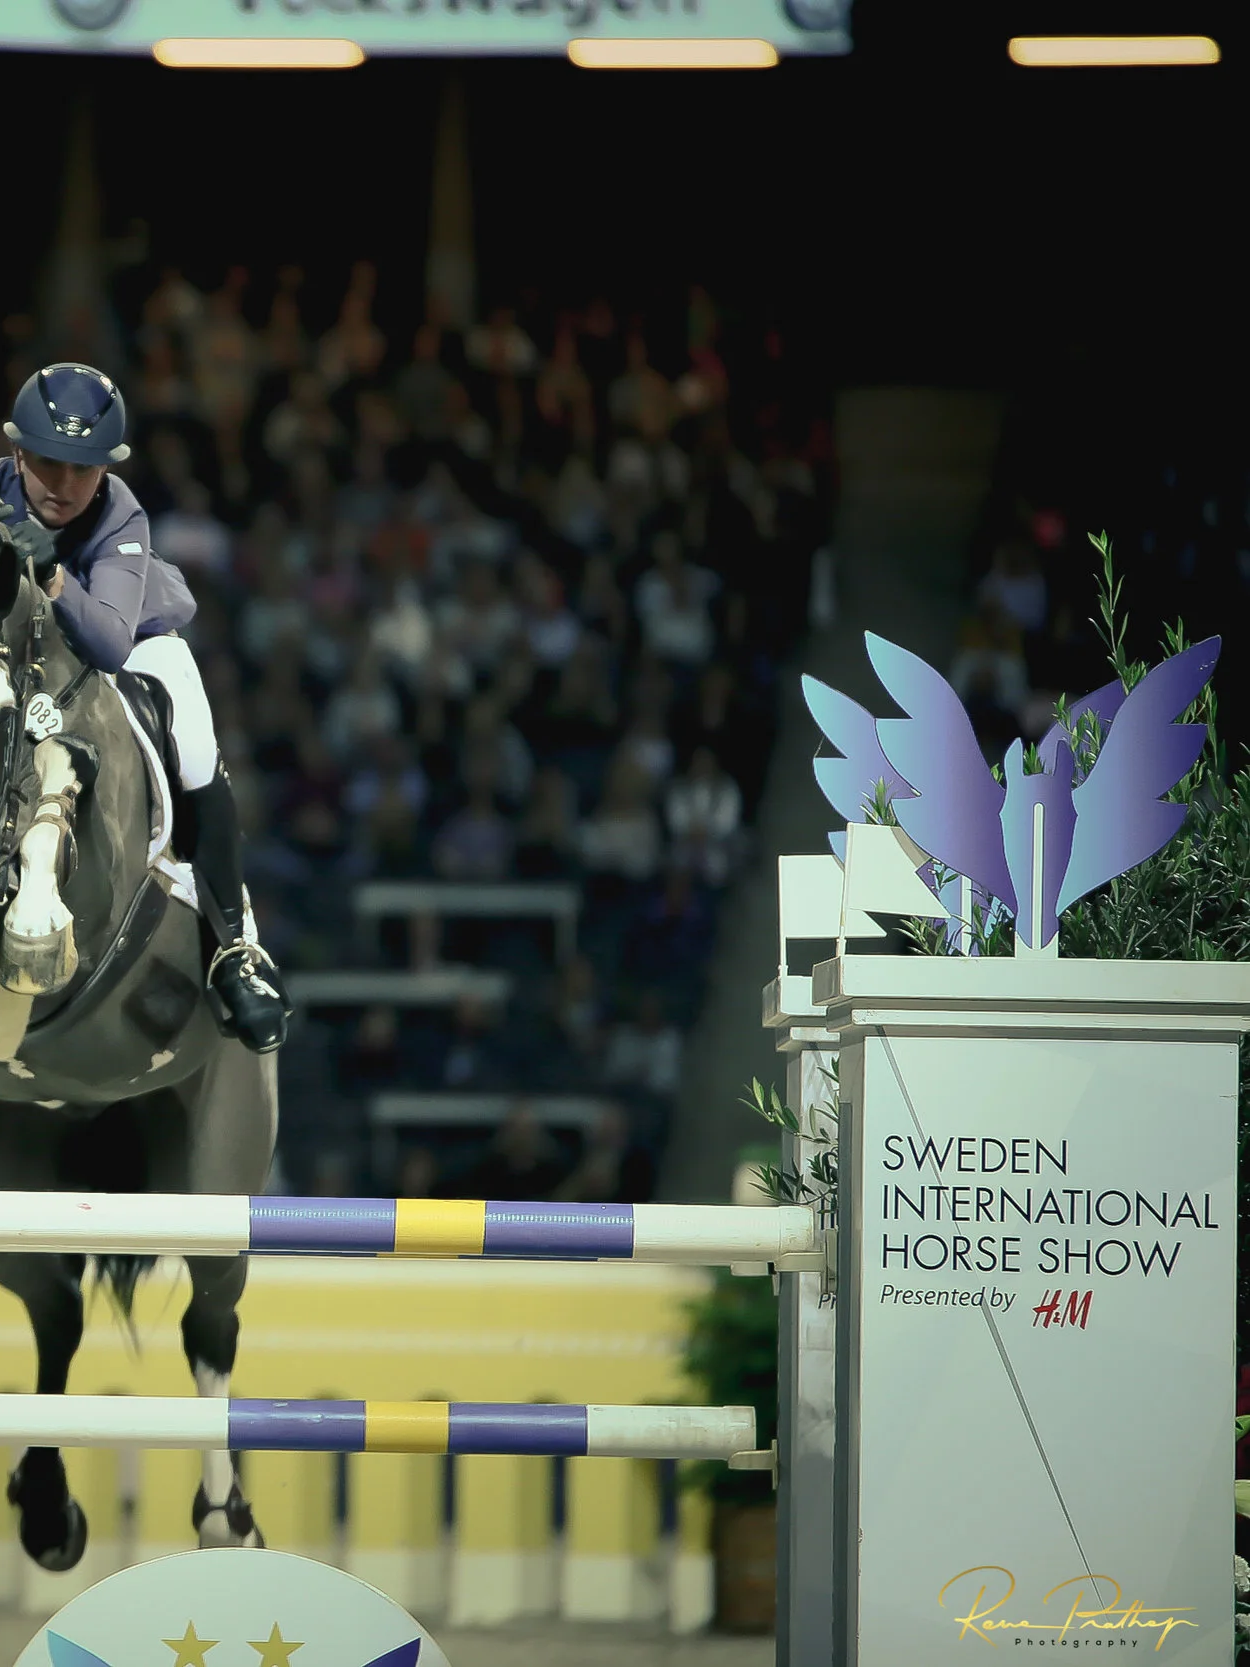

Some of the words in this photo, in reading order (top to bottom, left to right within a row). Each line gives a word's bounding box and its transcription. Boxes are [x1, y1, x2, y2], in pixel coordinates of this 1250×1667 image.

[29, 701, 59, 734] 082
[882, 1134, 1068, 1176] SWEDEN
[882, 1184, 1220, 1230] INTERNATIONAL
[881, 1233, 1022, 1273] HORSE
[1037, 1238, 1182, 1278] SHOW
[879, 1284, 986, 1308] Presented
[989, 1287, 1016, 1313] by
[1032, 1288, 1093, 1331] H&M
